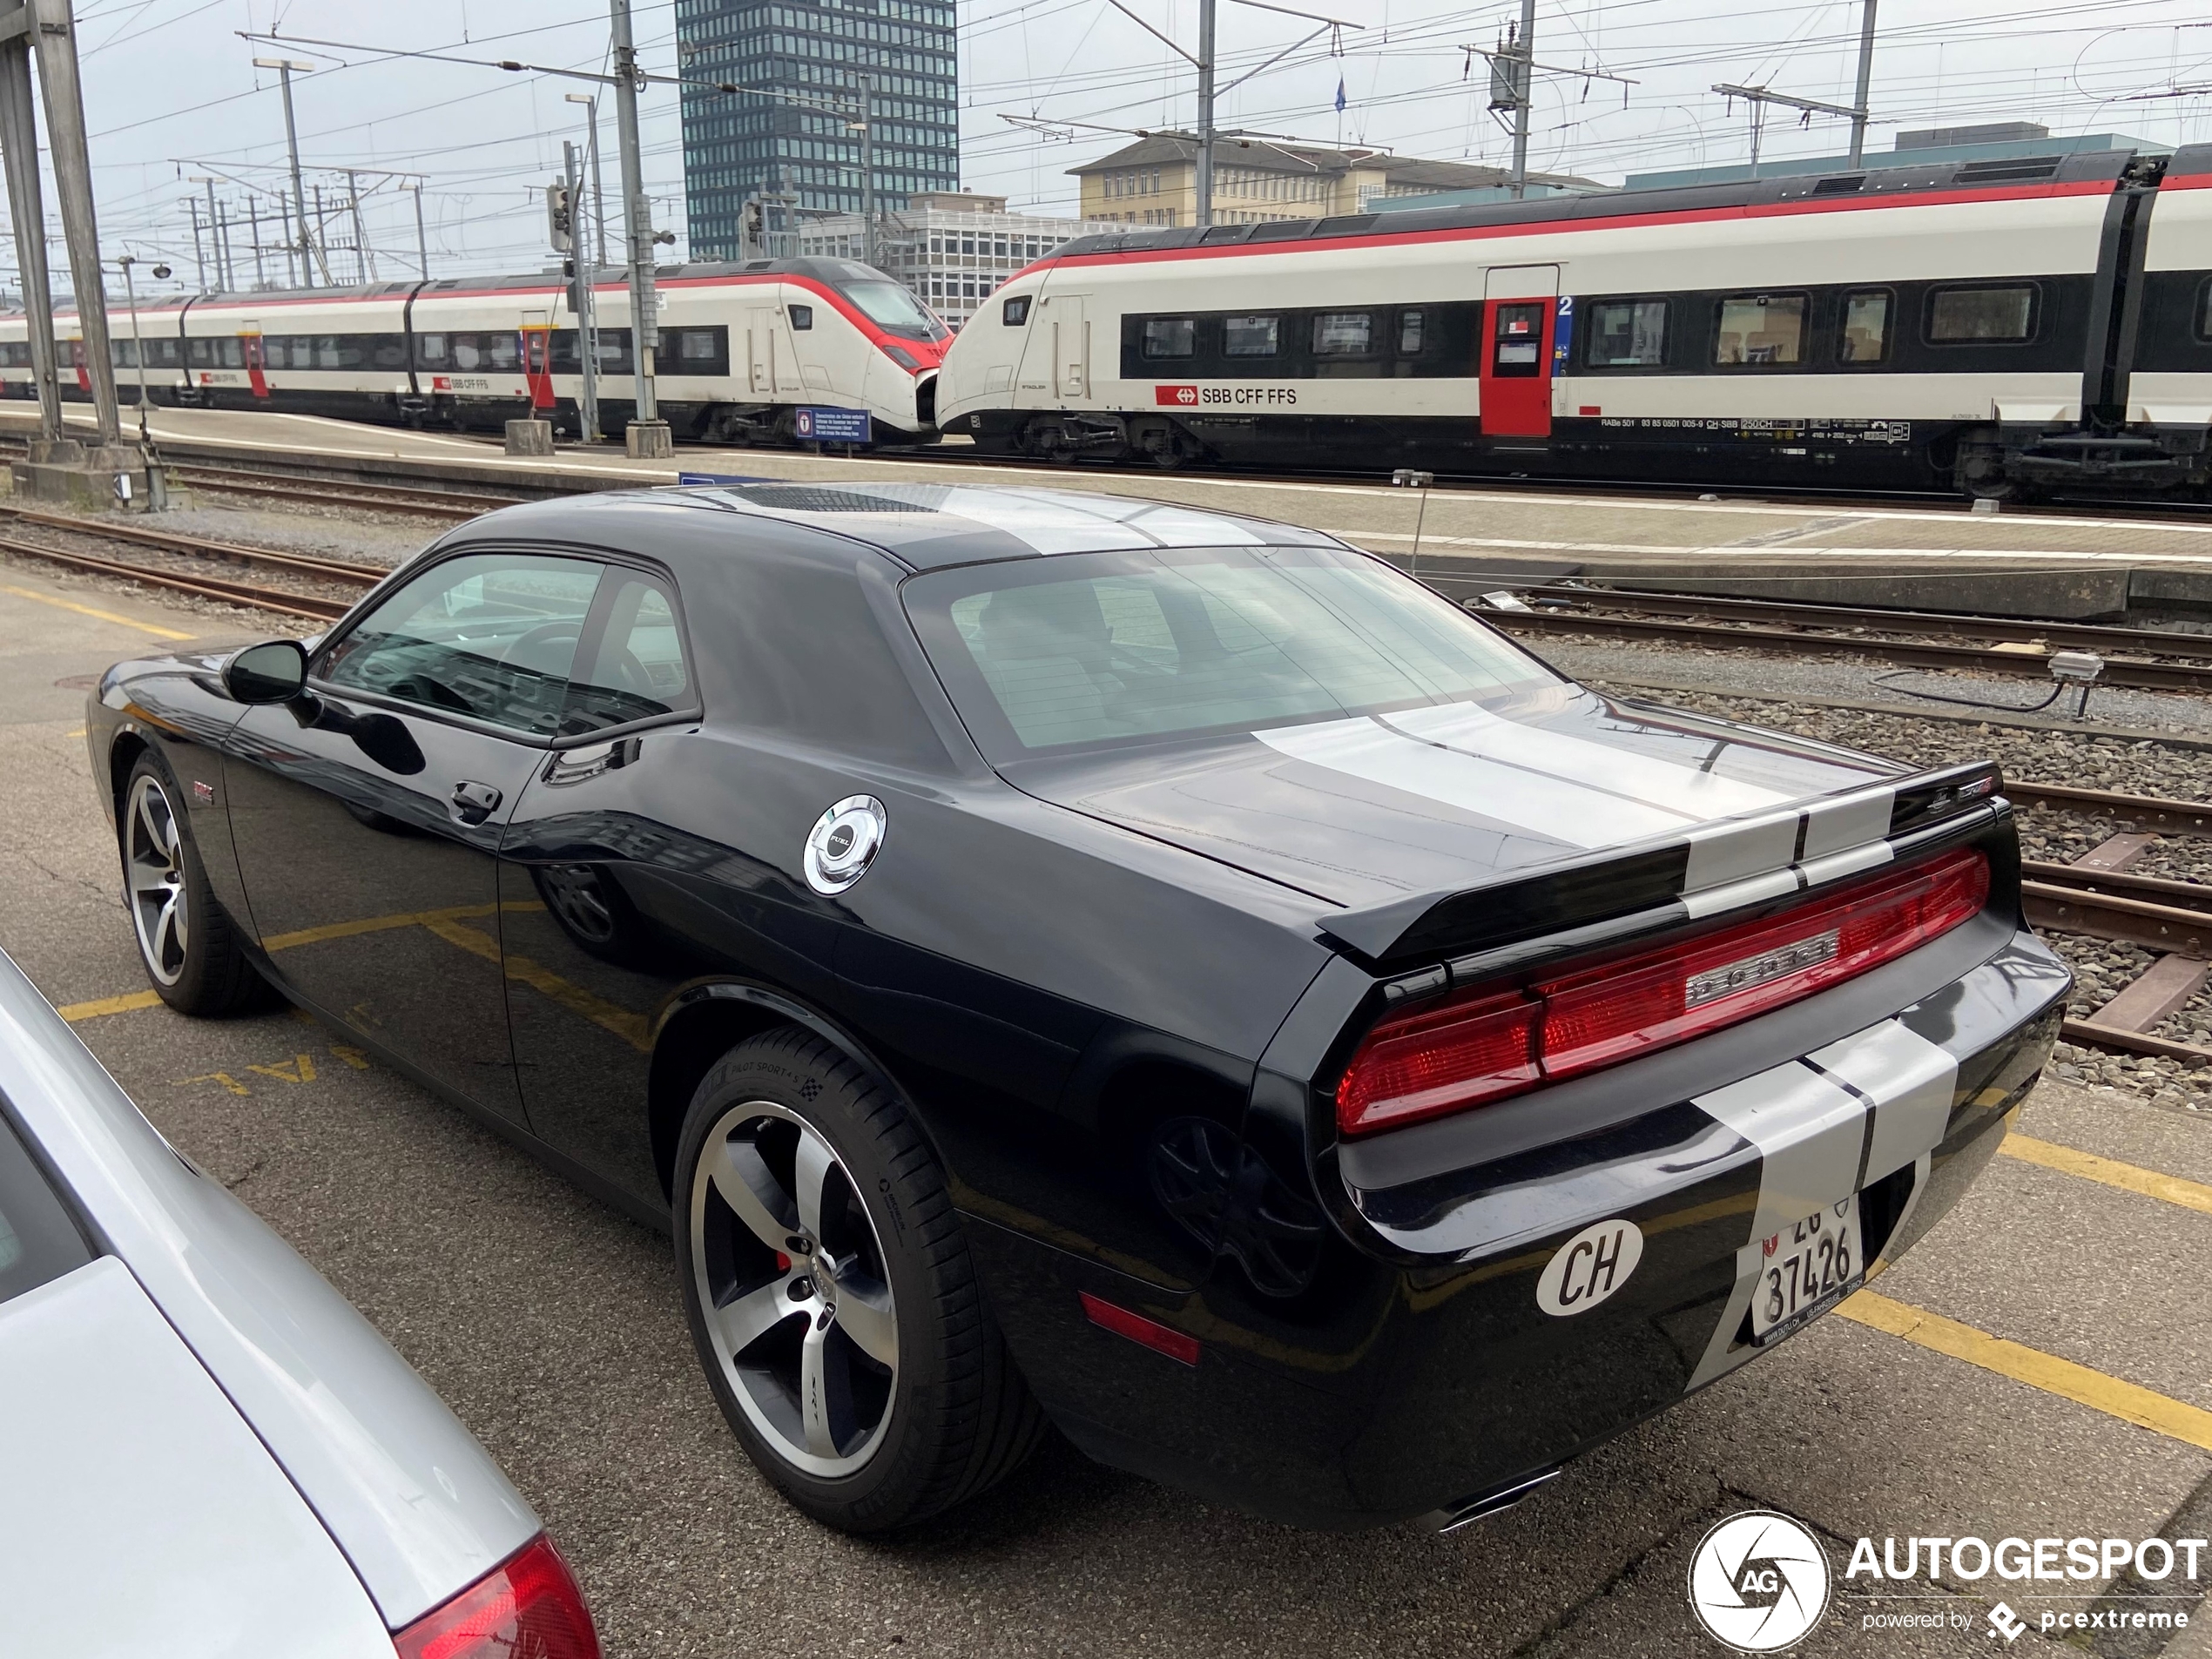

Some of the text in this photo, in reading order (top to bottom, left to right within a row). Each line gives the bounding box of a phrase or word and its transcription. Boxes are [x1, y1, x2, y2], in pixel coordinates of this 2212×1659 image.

[1558, 296, 1572, 315] 2
[1203, 388, 1297, 404] SBB CFF FFS
[1642, 419, 1650, 428] 93
[1652, 419, 1662, 428] 85
[1662, 419, 1680, 428] 0501
[830, 835, 850, 846] FUEL
[731, 1061, 755, 1075] PILOT
[756, 1062, 787, 1077] SPORT
[792, 1075, 799, 1083] S
[1558, 1229, 1623, 1306] CH
[1764, 1226, 1851, 1324] 37426
[1805, 1291, 1841, 1318] US-FAHRZEUGE
